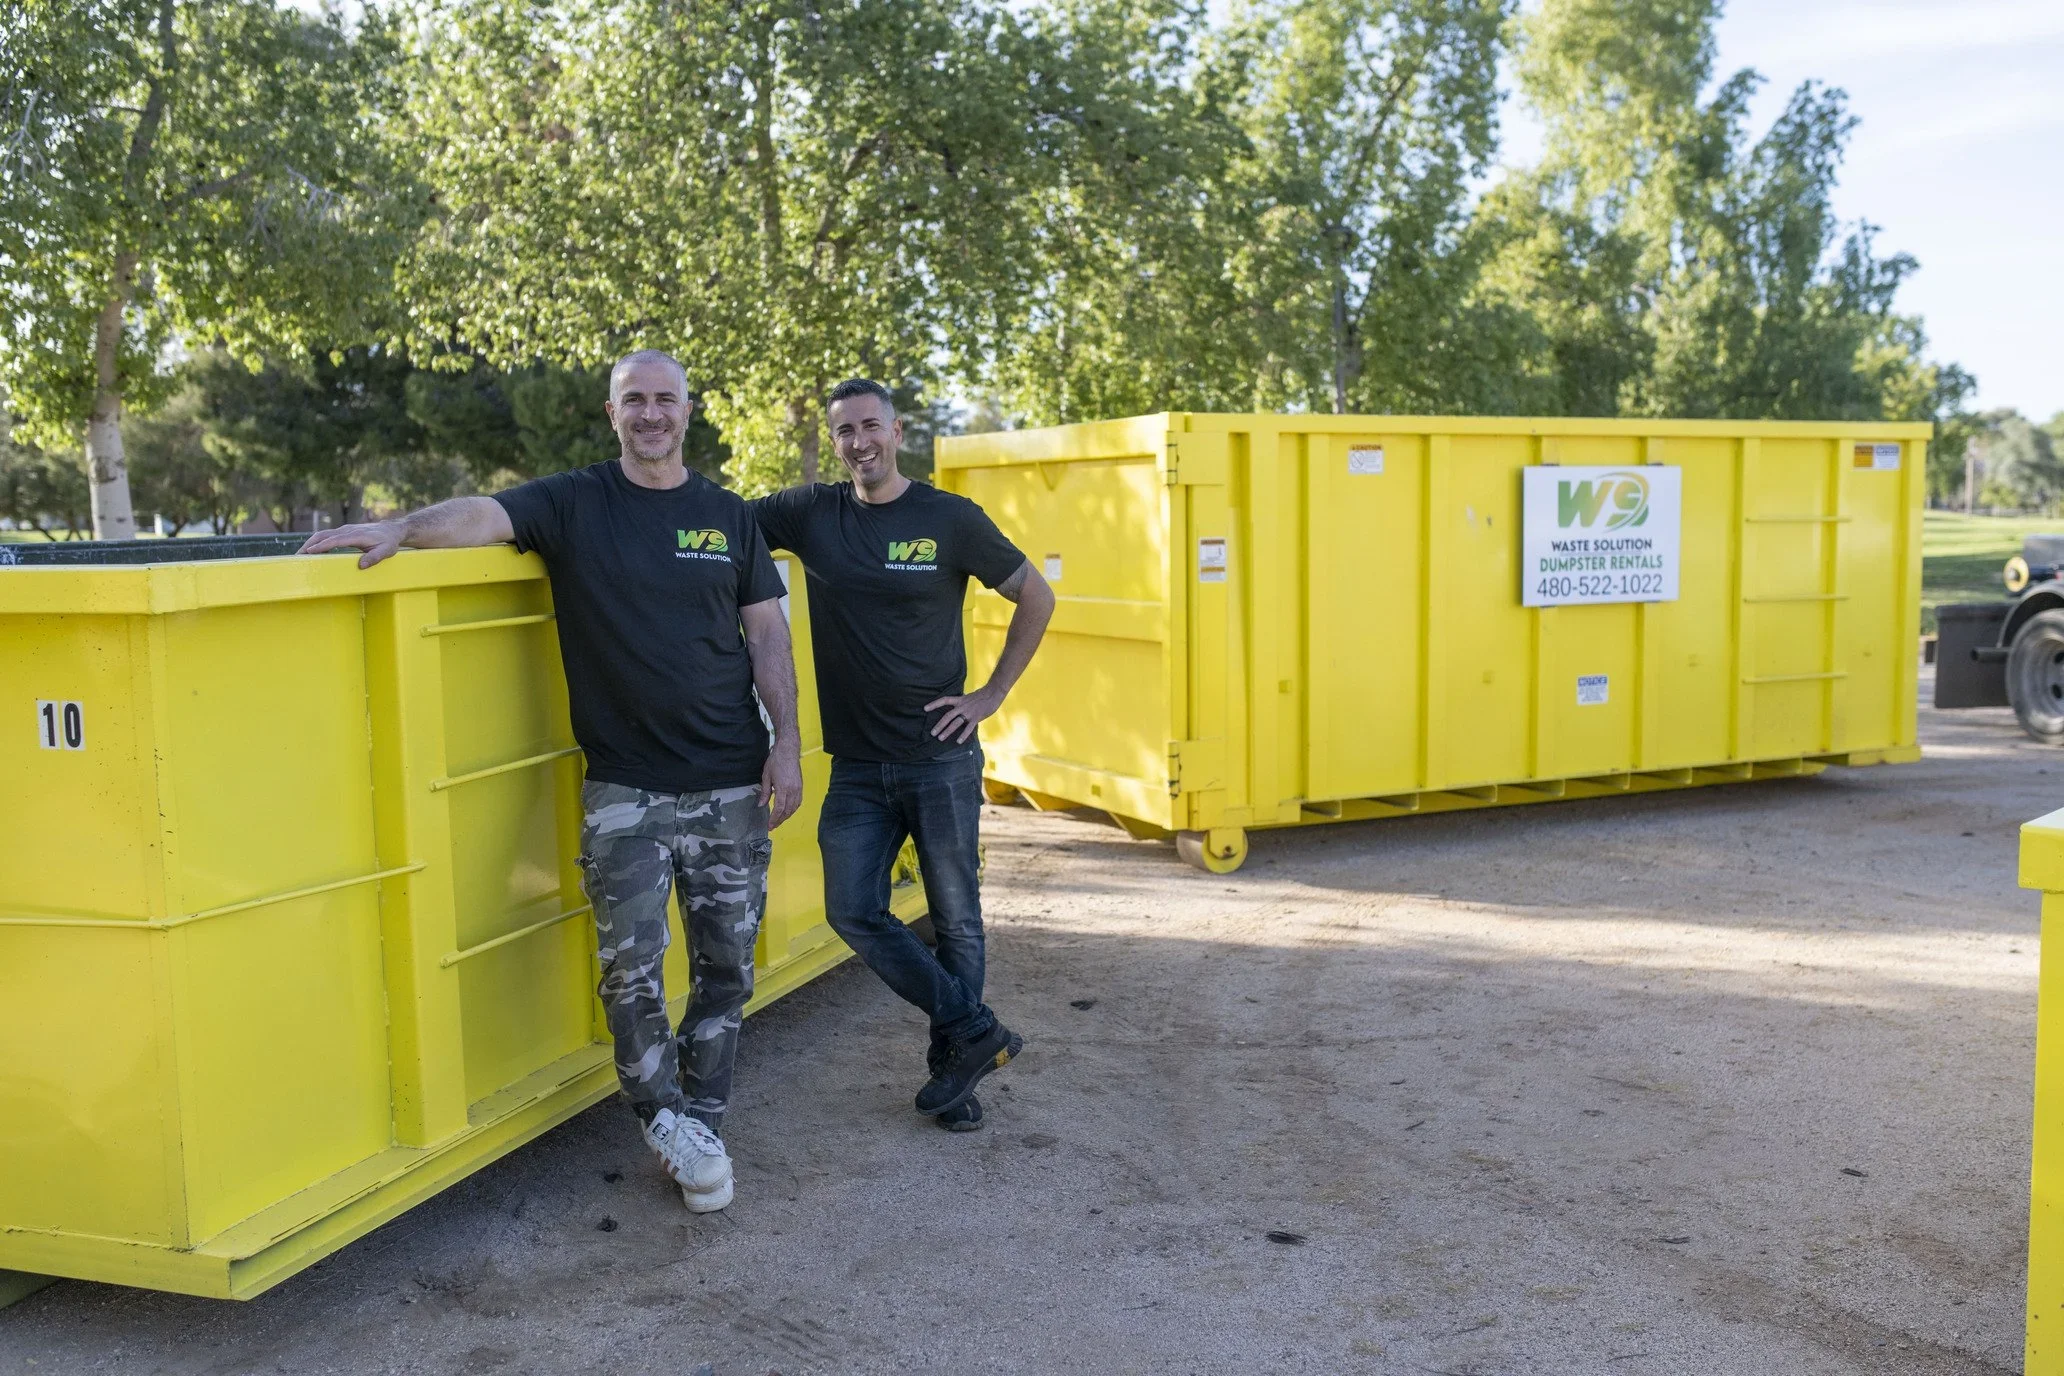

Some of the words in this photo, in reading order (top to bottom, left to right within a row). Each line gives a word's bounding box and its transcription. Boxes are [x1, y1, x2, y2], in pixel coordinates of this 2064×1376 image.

[1551, 540, 1589, 552] WASTE
[1594, 538, 1653, 551] SOLUTION
[675, 551, 699, 559] WASTE
[699, 552, 732, 563] SOLUTION
[1540, 557, 1606, 573] DUMPSTER
[1611, 555, 1663, 570] RENTALS
[1537, 573, 1663, 598] 480-522-1022
[42, 702, 82, 748] 10
